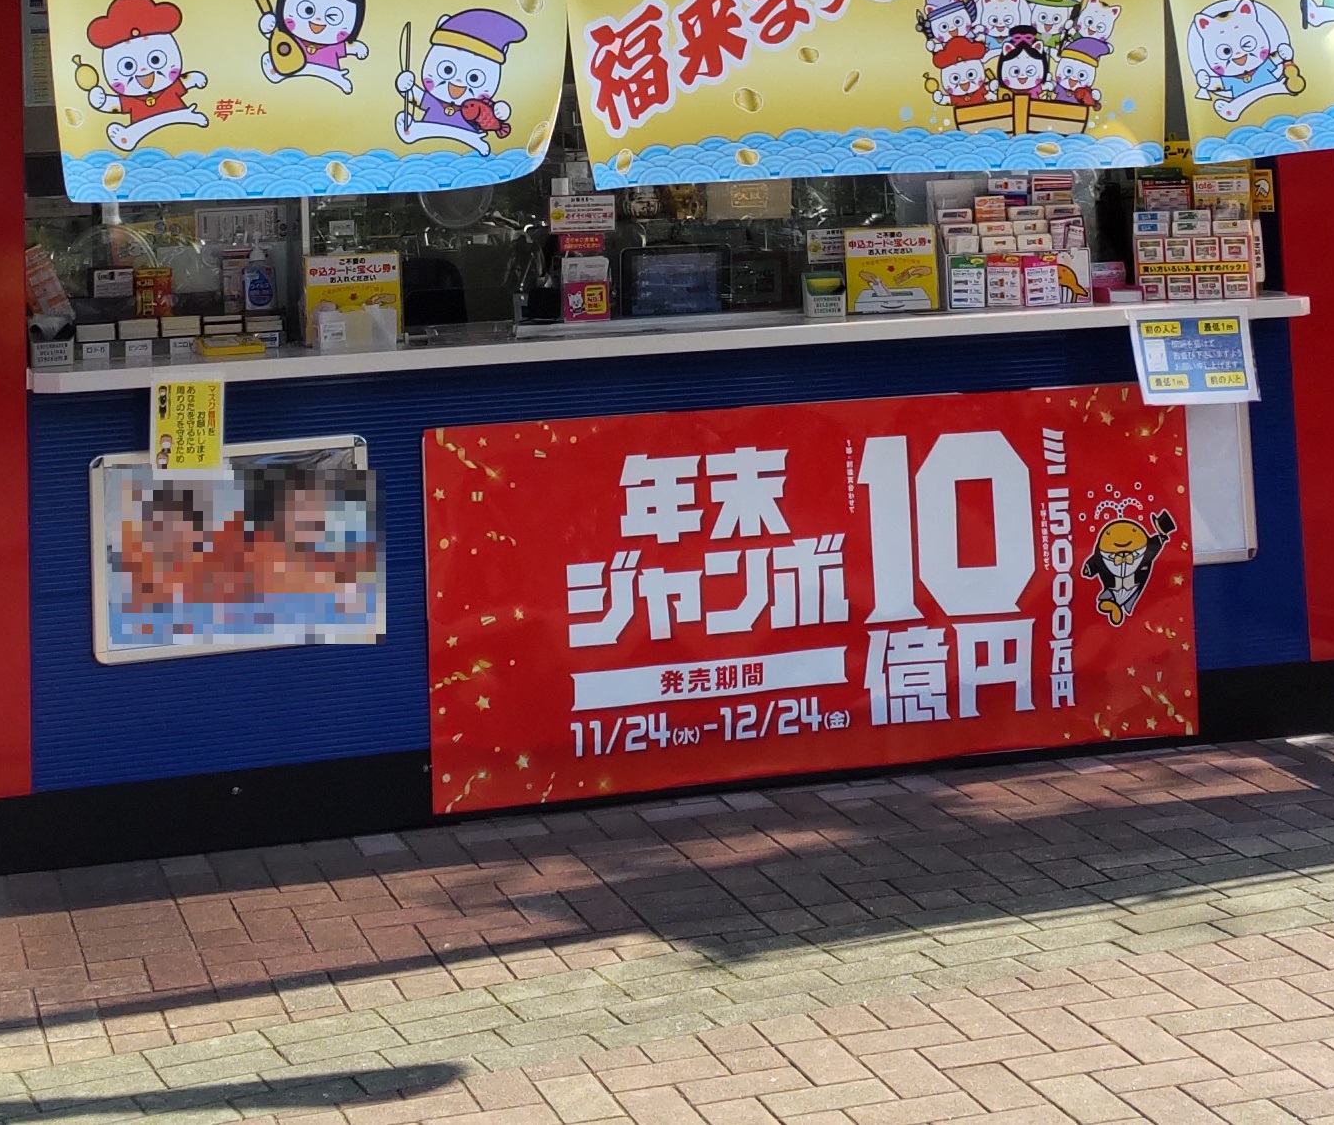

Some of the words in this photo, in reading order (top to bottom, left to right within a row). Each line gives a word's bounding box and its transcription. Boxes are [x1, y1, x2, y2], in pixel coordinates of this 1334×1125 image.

[618, 445, 791, 544] 年末
[856, 429, 1036, 624] 10
[565, 533, 850, 650] ジャンボ
[659, 661, 765, 696] 発売期間
[864, 618, 1037, 726] 億円
